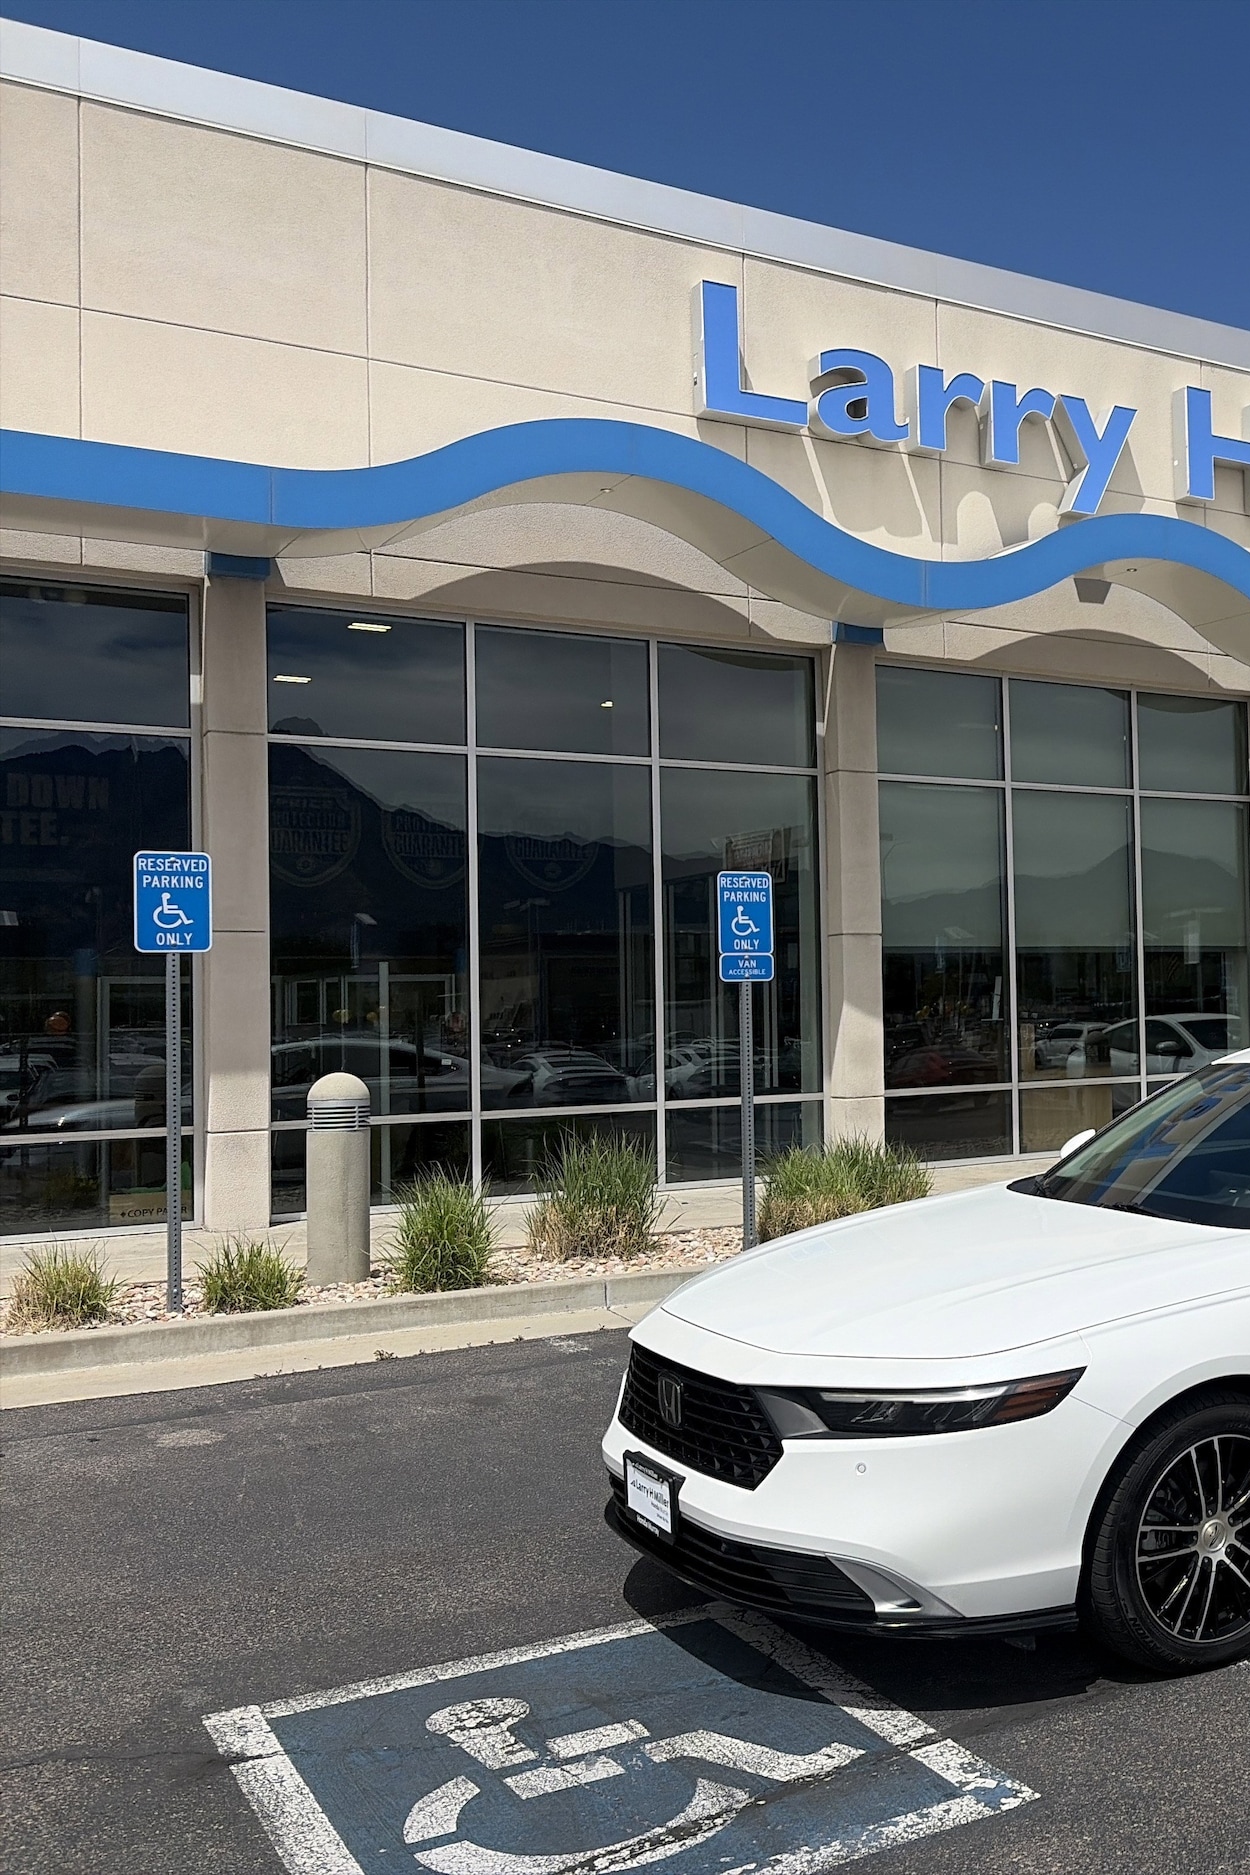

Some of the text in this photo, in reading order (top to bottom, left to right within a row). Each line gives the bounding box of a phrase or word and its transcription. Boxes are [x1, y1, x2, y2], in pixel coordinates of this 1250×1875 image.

[698, 279, 1138, 516] Larry
[272, 829, 349, 852] UARANTEE
[138, 857, 207, 872] RESERVED
[142, 875, 204, 889] PARKING
[720, 876, 769, 889] RESERVED
[723, 891, 767, 903] PARKING
[156, 932, 193, 945] ONLY
[733, 939, 760, 950] ONLY
[738, 959, 757, 968] VAN
[728, 968, 766, 976] ACCESSIBLE
[127, 1206, 188, 1218] COPY PAR
[636, 1479, 649, 1498] Larry
[654, 1490, 669, 1509] Miller
